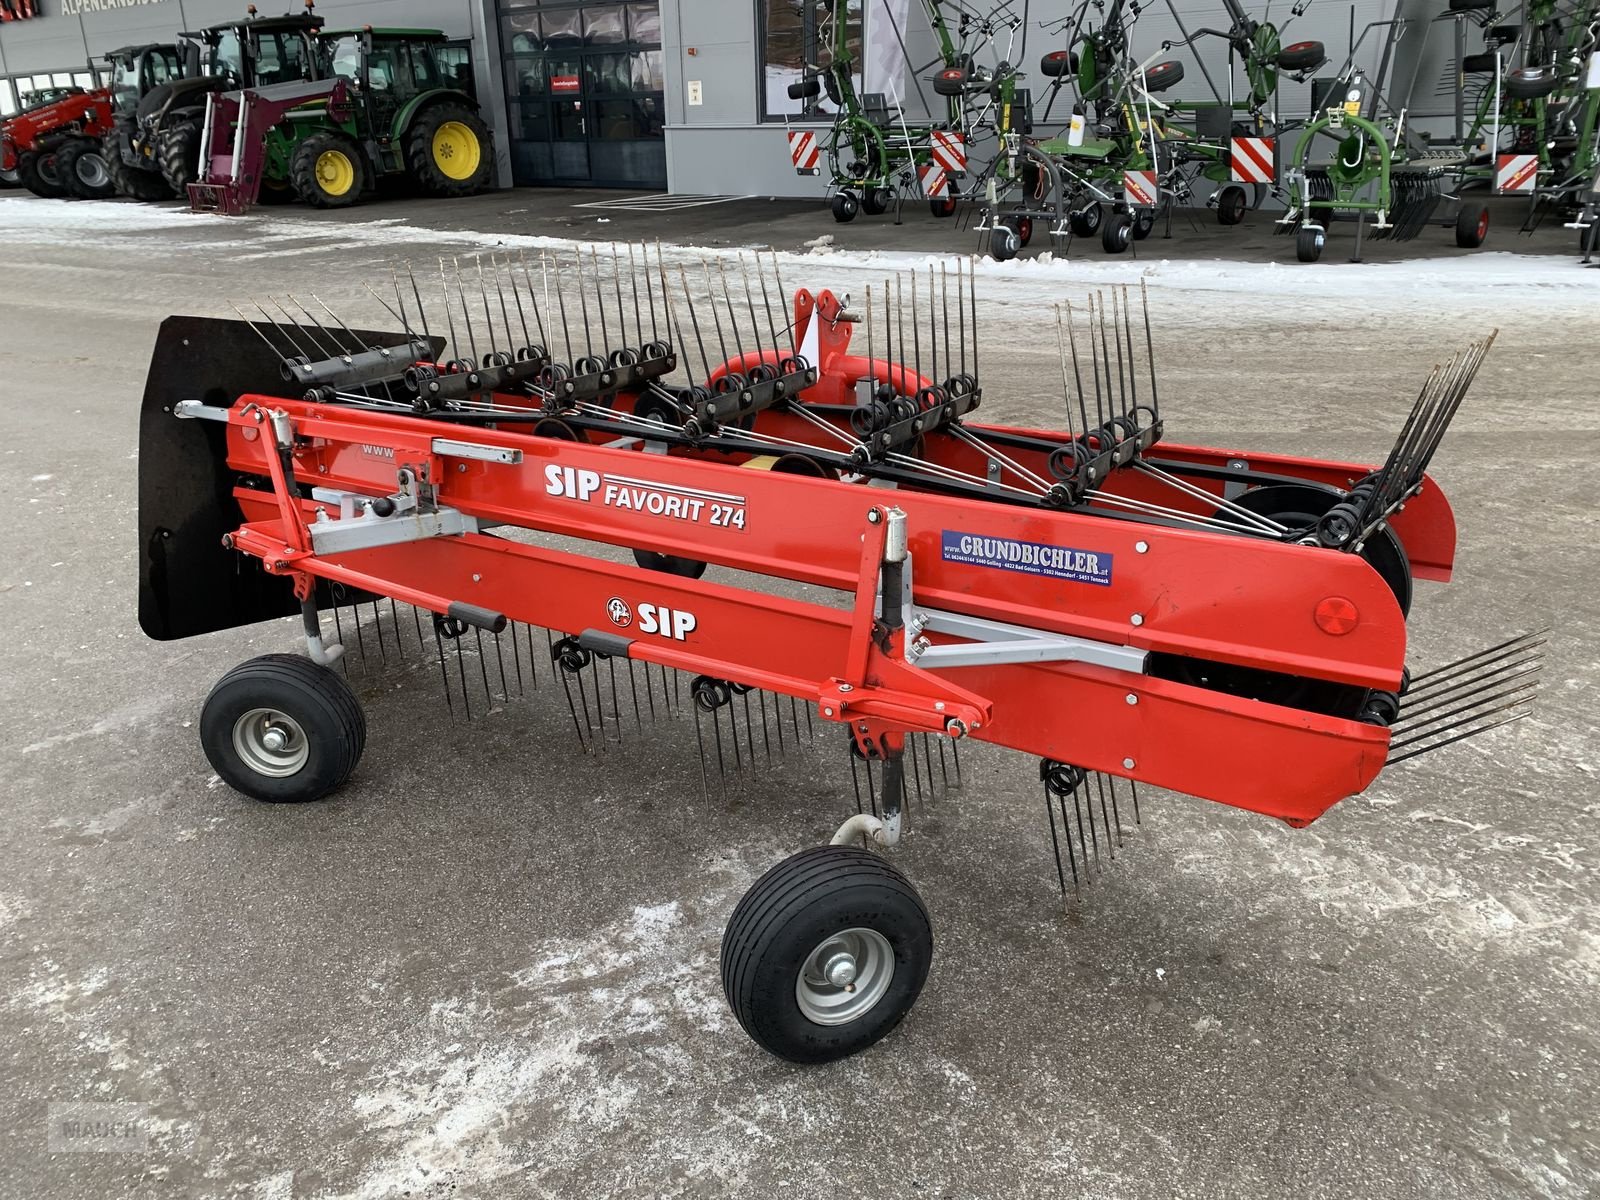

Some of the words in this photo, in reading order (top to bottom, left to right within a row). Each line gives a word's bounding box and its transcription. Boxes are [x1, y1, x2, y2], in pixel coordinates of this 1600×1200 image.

[544, 464, 601, 502] SIP
[604, 485, 705, 521] FAVORIT
[709, 504, 746, 530] 274
[637, 603, 697, 641] SIP
